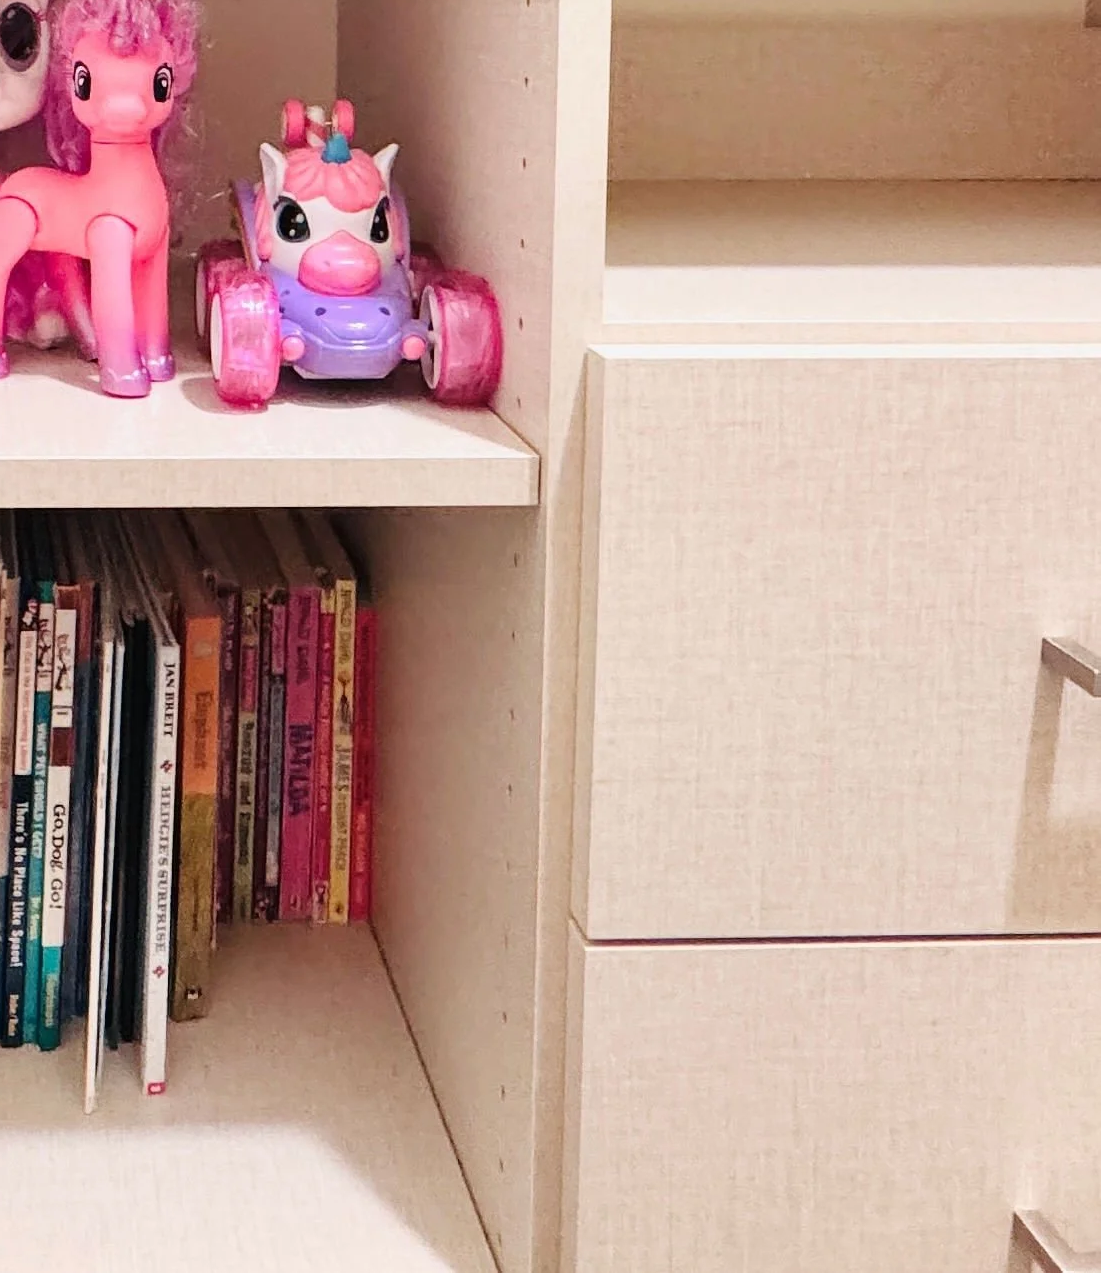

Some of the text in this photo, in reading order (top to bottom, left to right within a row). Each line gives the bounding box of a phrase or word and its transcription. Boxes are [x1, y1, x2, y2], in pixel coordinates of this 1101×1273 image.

[163, 662, 176, 737] JAN BRETT
[289, 724, 314, 816] MATILDA
[336, 744, 351, 792] JAMES
[9, 801, 30, 967] There's No Place Like Space!
[49, 878, 63, 909] Go!
[155, 869, 169, 953] SURPRISE
